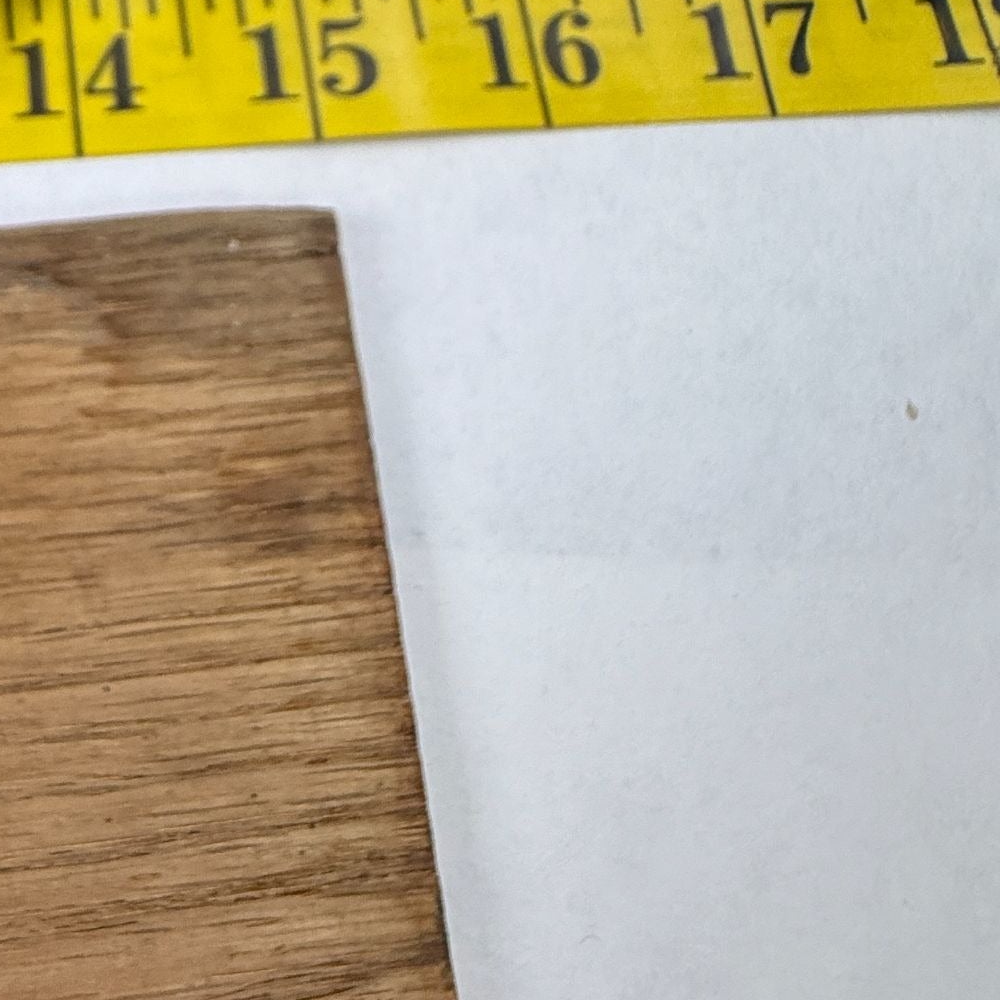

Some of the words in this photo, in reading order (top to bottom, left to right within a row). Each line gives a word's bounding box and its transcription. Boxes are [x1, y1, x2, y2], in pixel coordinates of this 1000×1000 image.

[11, 31, 145, 118] 14
[243, 14, 380, 104] 15
[471, 8, 602, 91] 16
